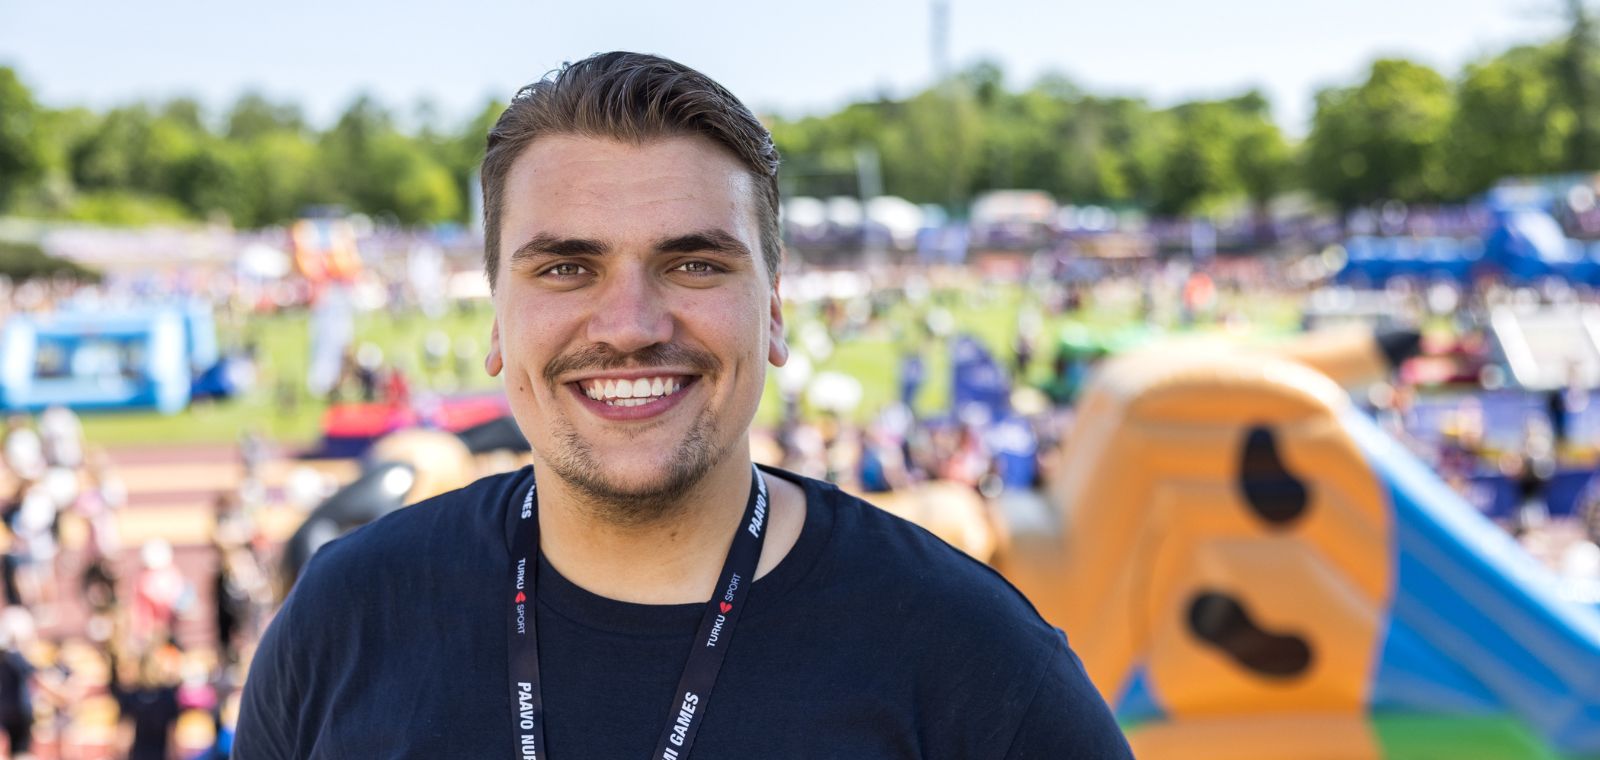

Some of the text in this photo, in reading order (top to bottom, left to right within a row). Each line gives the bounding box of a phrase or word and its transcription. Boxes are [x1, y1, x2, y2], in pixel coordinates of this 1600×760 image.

[748, 493, 767, 538] PAAVO
[516, 558, 526, 635] TURKU SPORT
[706, 573, 742, 648] TURKU SPORT
[517, 682, 534, 730] PAAVO
[669, 691, 699, 747] GAMES
